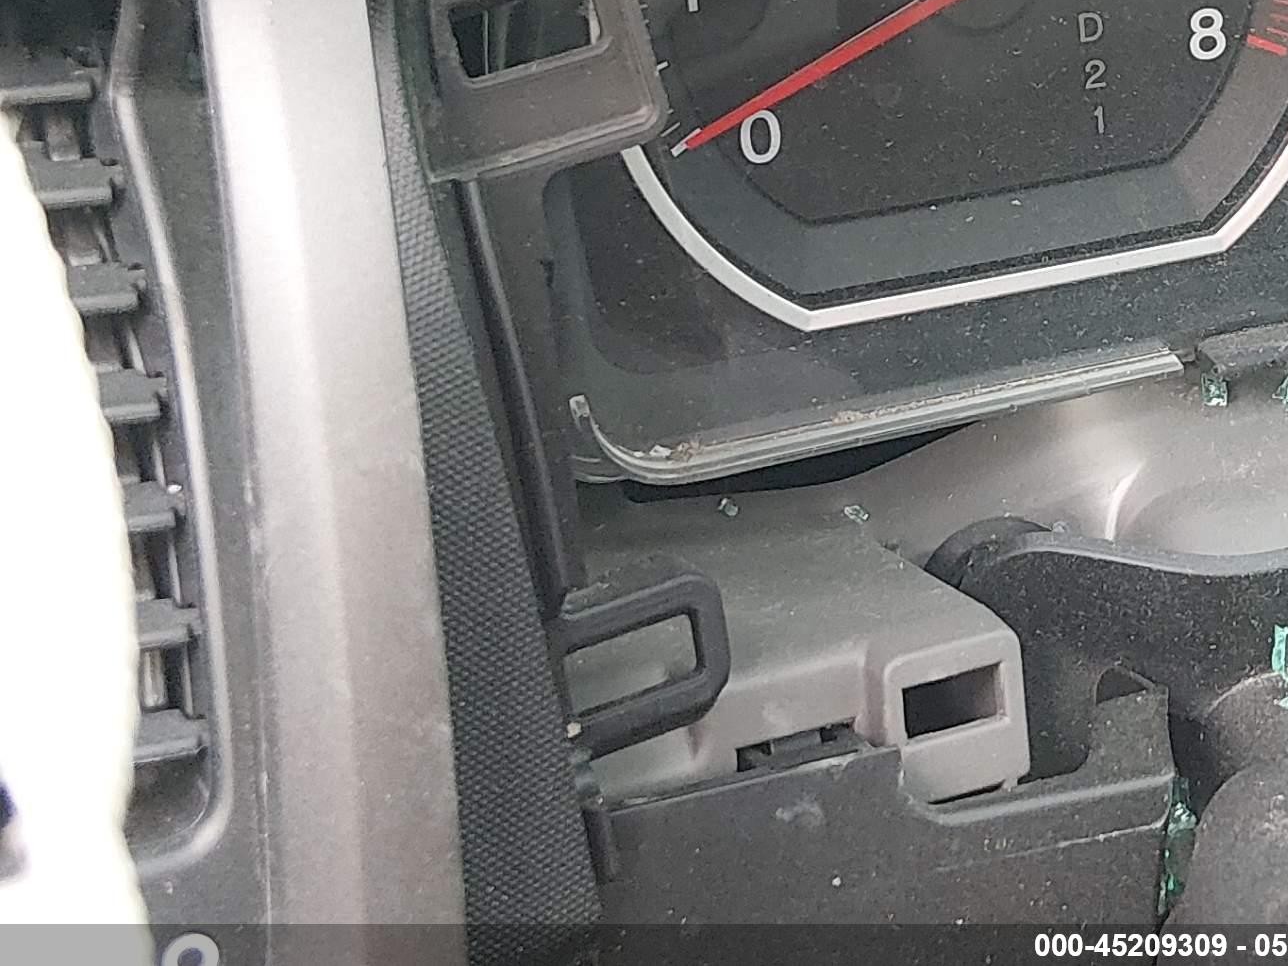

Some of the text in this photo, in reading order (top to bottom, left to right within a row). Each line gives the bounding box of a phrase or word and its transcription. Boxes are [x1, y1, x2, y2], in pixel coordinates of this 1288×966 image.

[1078, 12, 1104, 43] D
[1189, 7, 1227, 60] 8
[1084, 60, 1107, 89] 2
[1093, 106, 1105, 134] 1
[739, 110, 781, 164] 0
